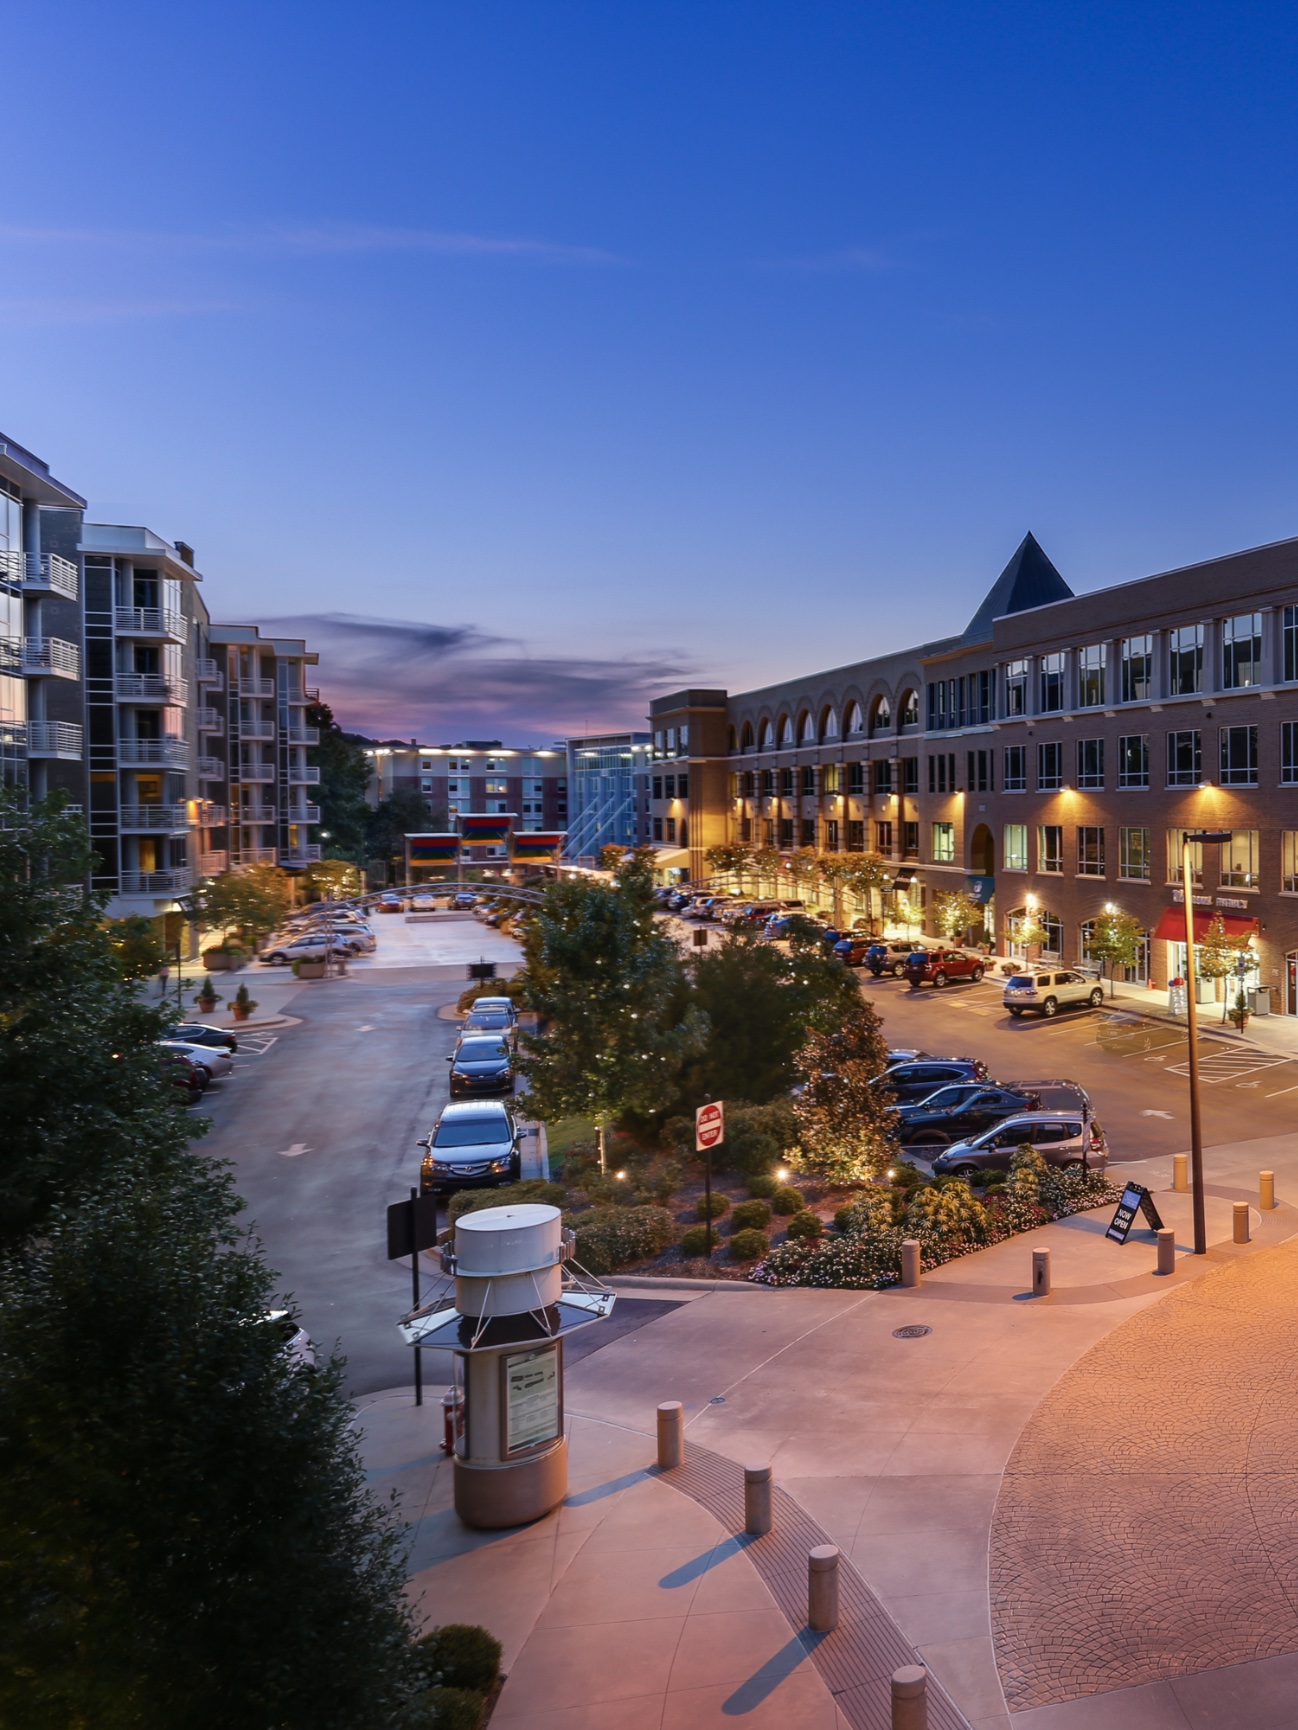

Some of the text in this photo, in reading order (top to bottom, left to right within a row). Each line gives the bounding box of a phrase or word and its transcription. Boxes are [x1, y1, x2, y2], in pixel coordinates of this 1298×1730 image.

[700, 1110, 719, 1123] DO NOT
[702, 1130, 717, 1140] ENTER
[1117, 1208, 1132, 1221] NOW
[1113, 1217, 1129, 1230] OPEN
